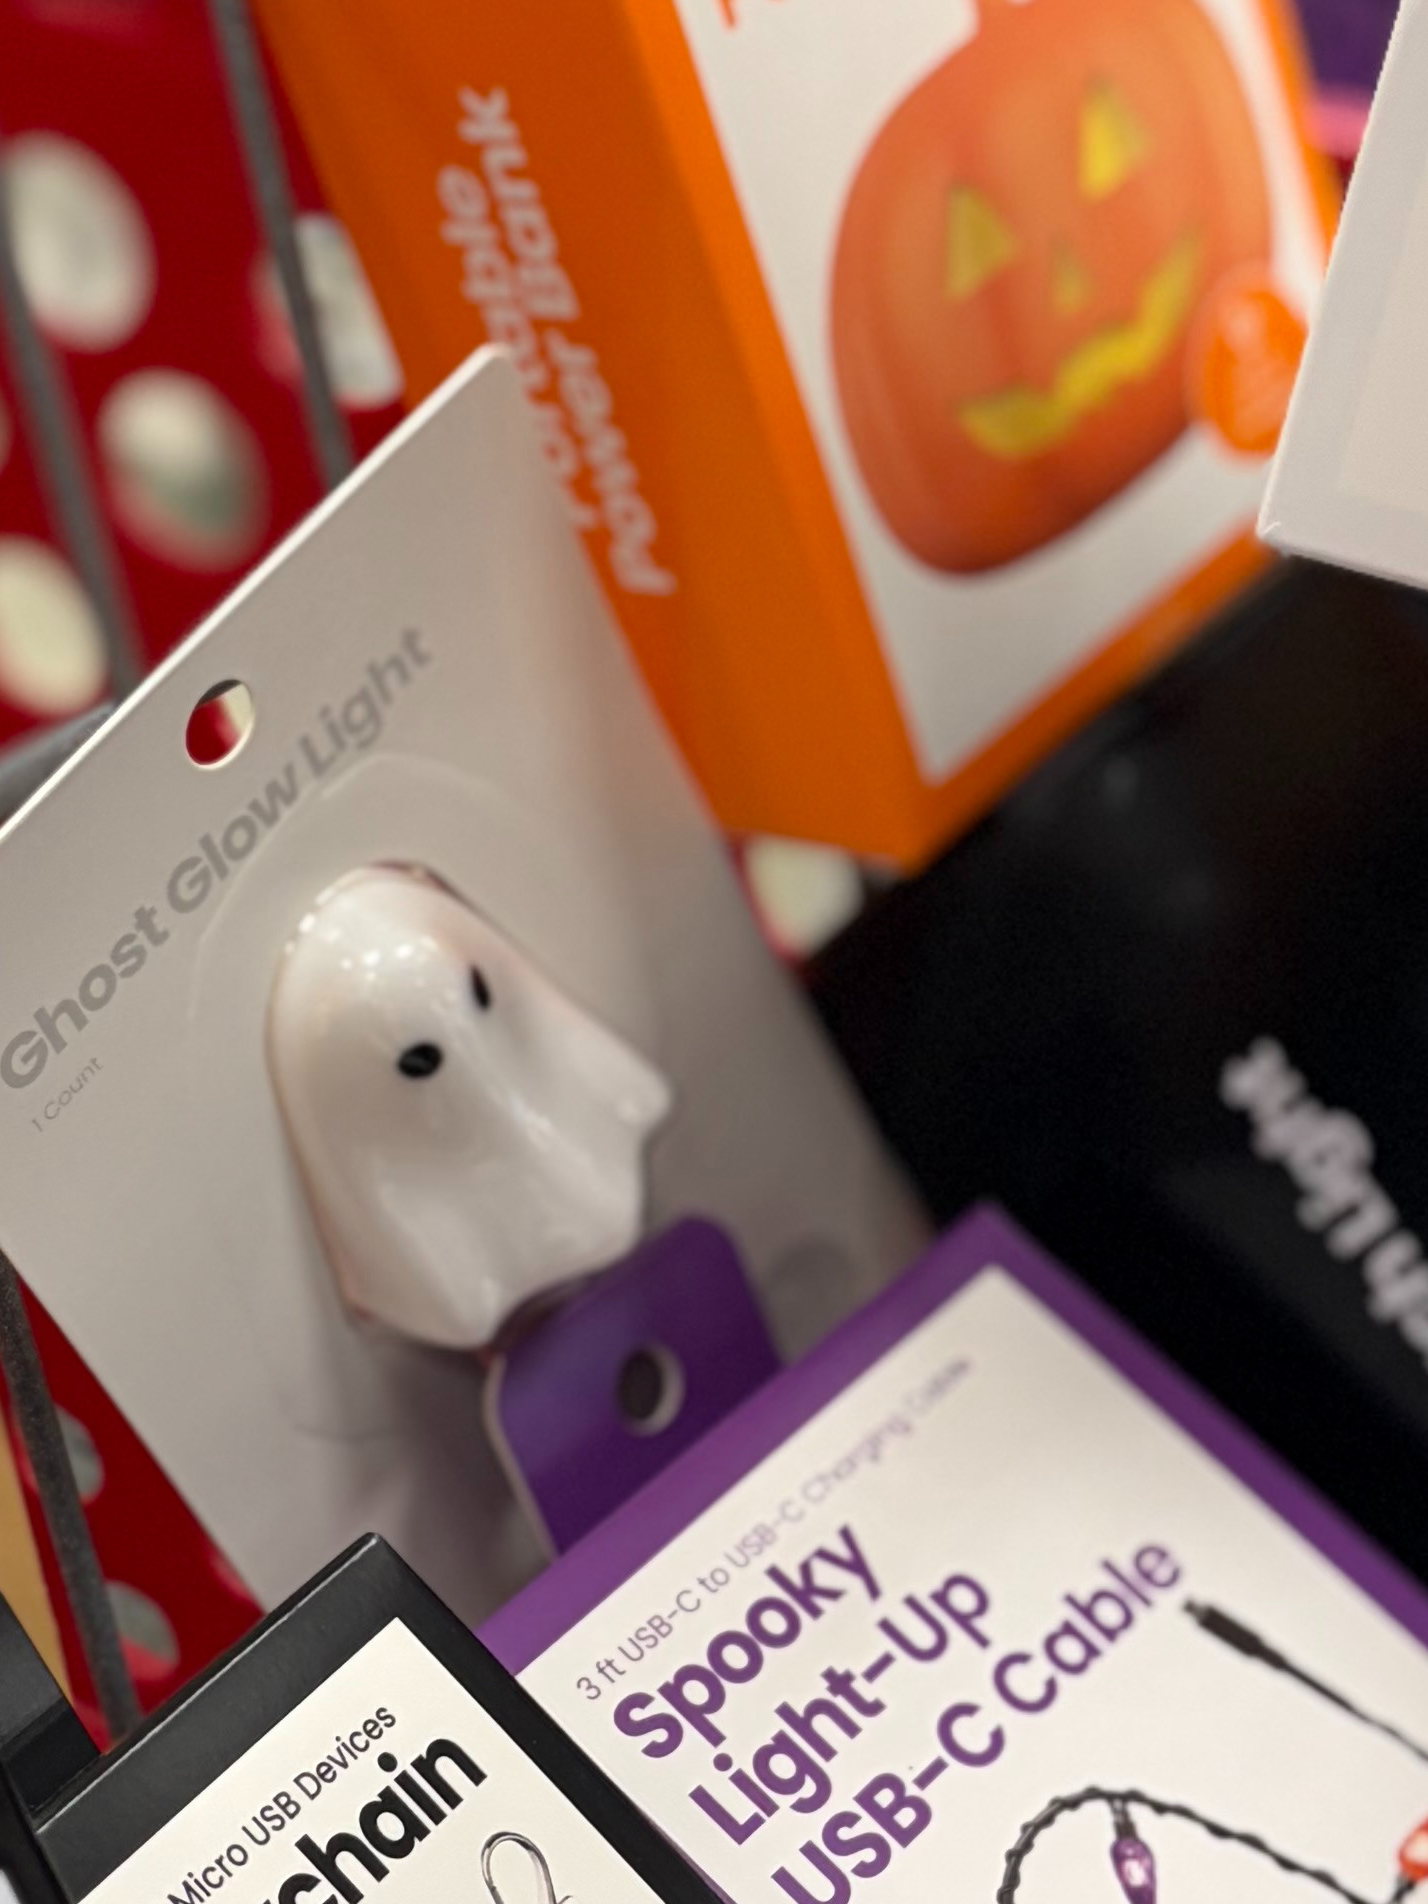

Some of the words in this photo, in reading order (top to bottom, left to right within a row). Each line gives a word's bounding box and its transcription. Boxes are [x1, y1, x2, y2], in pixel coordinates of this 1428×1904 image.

[457, 86, 580, 322] Bank
[541, 327, 676, 596] Power
[163, 763, 307, 916] Glow
[297, 626, 436, 781] Light
[43, 1056, 103, 1121] Count
[577, 1676, 603, 1701] 3
[595, 1651, 628, 1685] ft
[618, 1588, 703, 1666] USB-C
[696, 1564, 731, 1597] to
[725, 1498, 807, 1573] USB-C
[612, 1523, 885, 1760] Spooky
[687, 1572, 993, 1847] Light-Up
[992, 1542, 1184, 1716] Cable
[240, 1786, 302, 1851] USB
[288, 1704, 398, 1802] Devices
